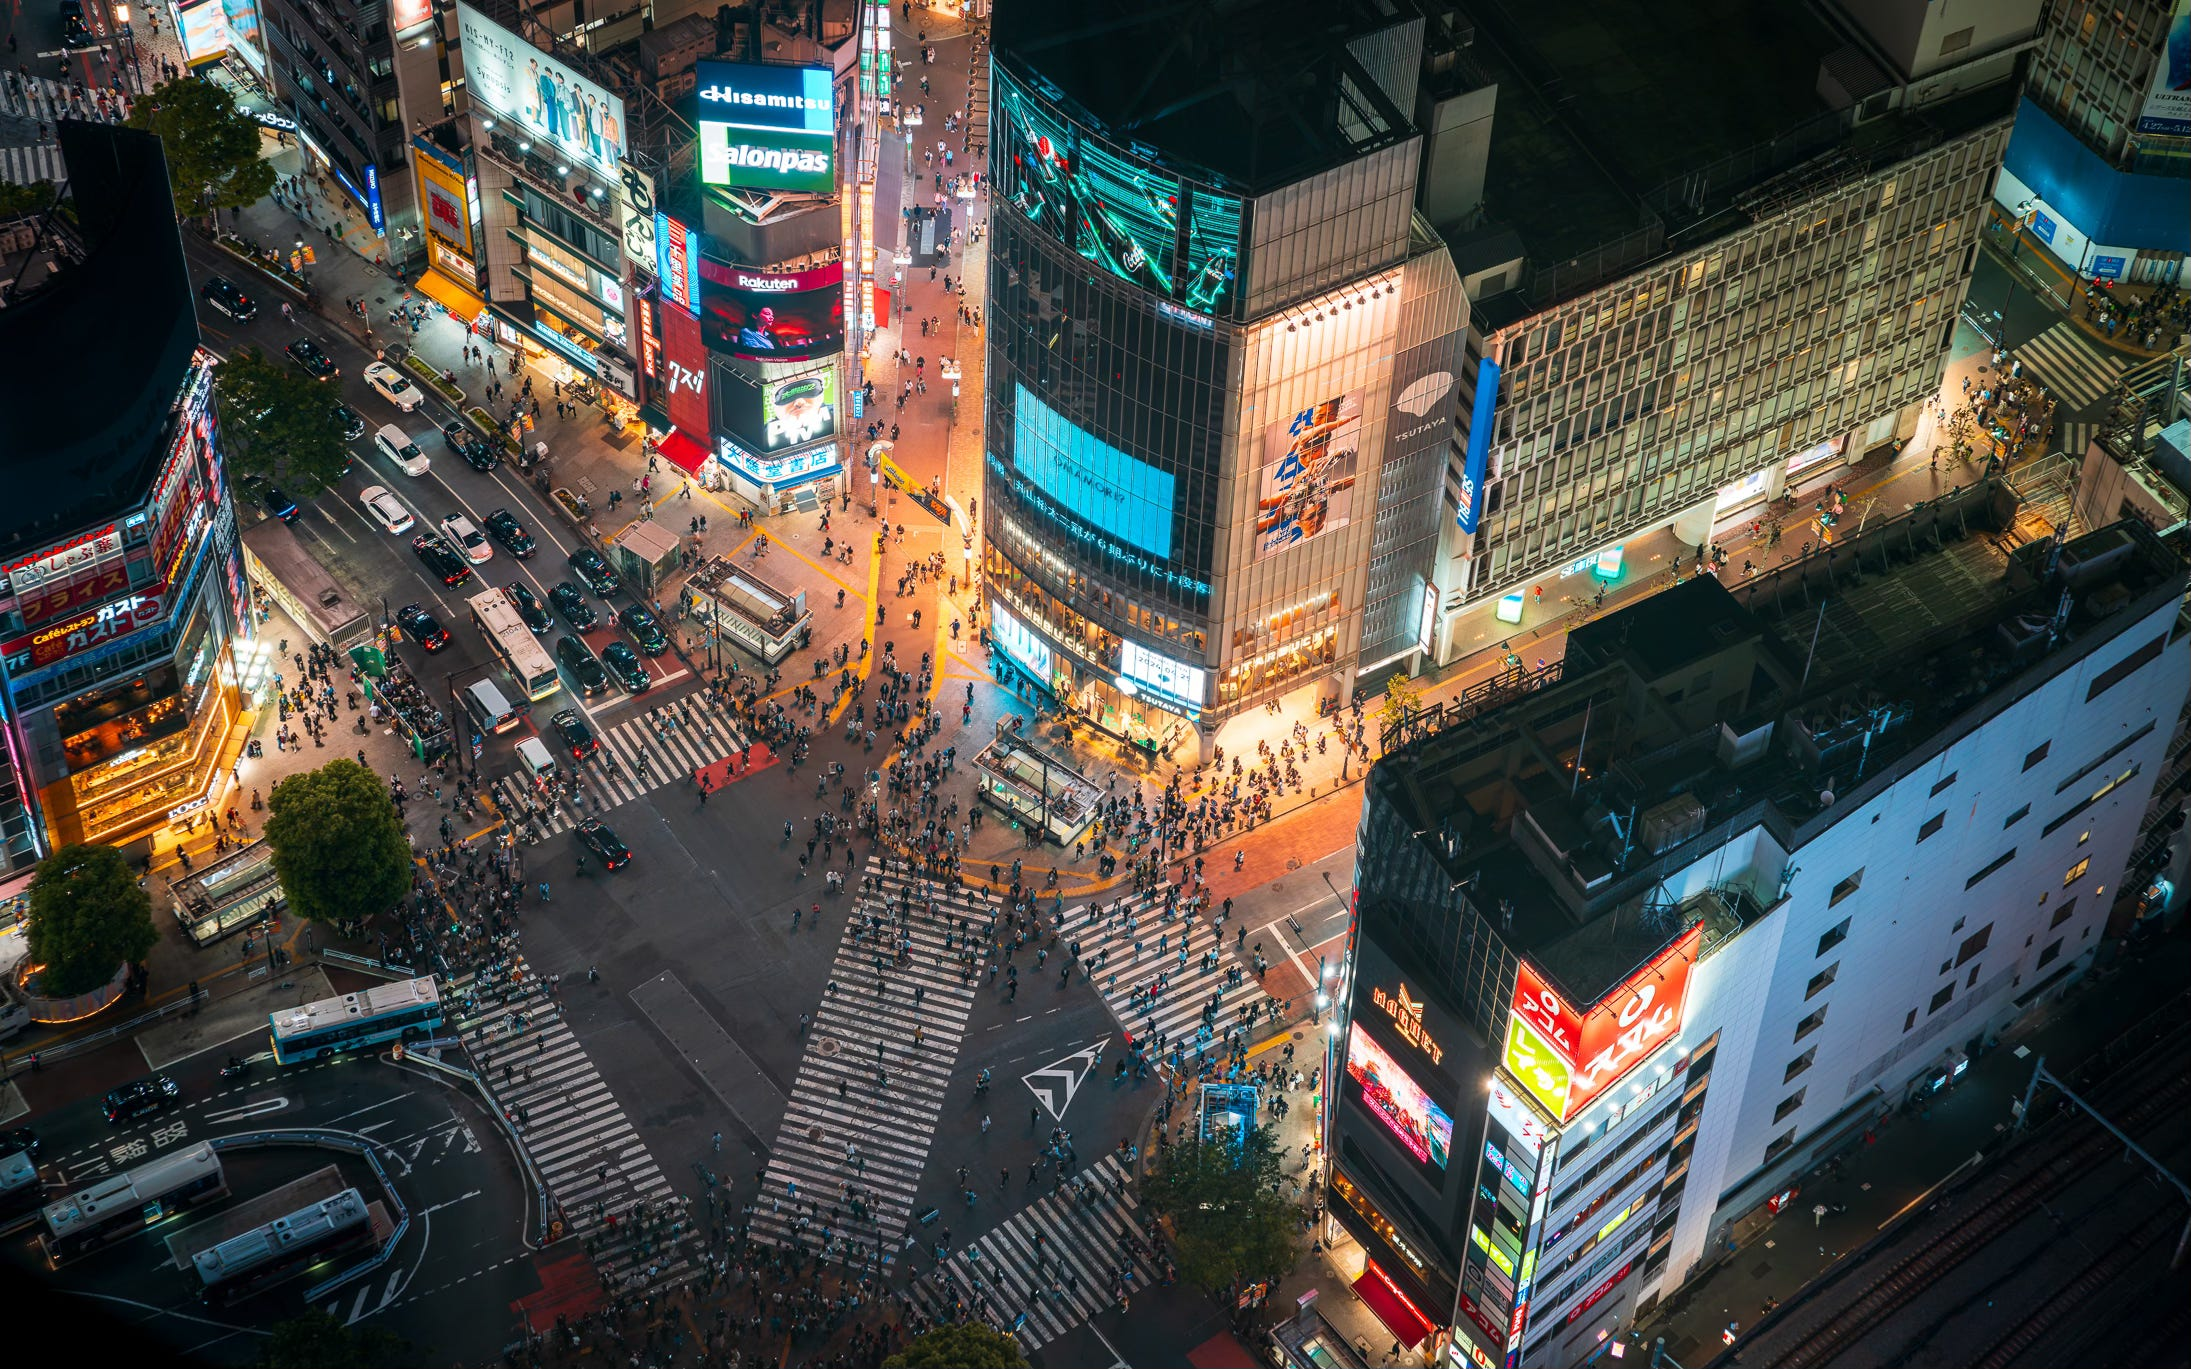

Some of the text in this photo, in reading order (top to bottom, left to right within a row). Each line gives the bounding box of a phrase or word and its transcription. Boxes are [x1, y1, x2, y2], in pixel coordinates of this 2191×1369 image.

[699, 85, 831, 110] Hisamitsu
[708, 144, 830, 174] Salonpas
[738, 275, 798, 290] Rakuten
[1395, 416, 1447, 442] TSUTAYA
[50, 537, 114, 571] しゃぶ葉
[97, 595, 147, 623] ガスト
[1005, 588, 1098, 662] STARBUCKS
[66, 617, 127, 652] ガスト
[1230, 624, 1336, 678] STARBUCKS
[5, 651, 31, 672] 7F
[1141, 693, 1181, 715] TSUTAYA
[1374, 987, 1443, 1066] MAGNET
[1522, 991, 1570, 1051] アコム
[109, 1119, 189, 1166] 路線
[1465, 1300, 1500, 1343] アコム
